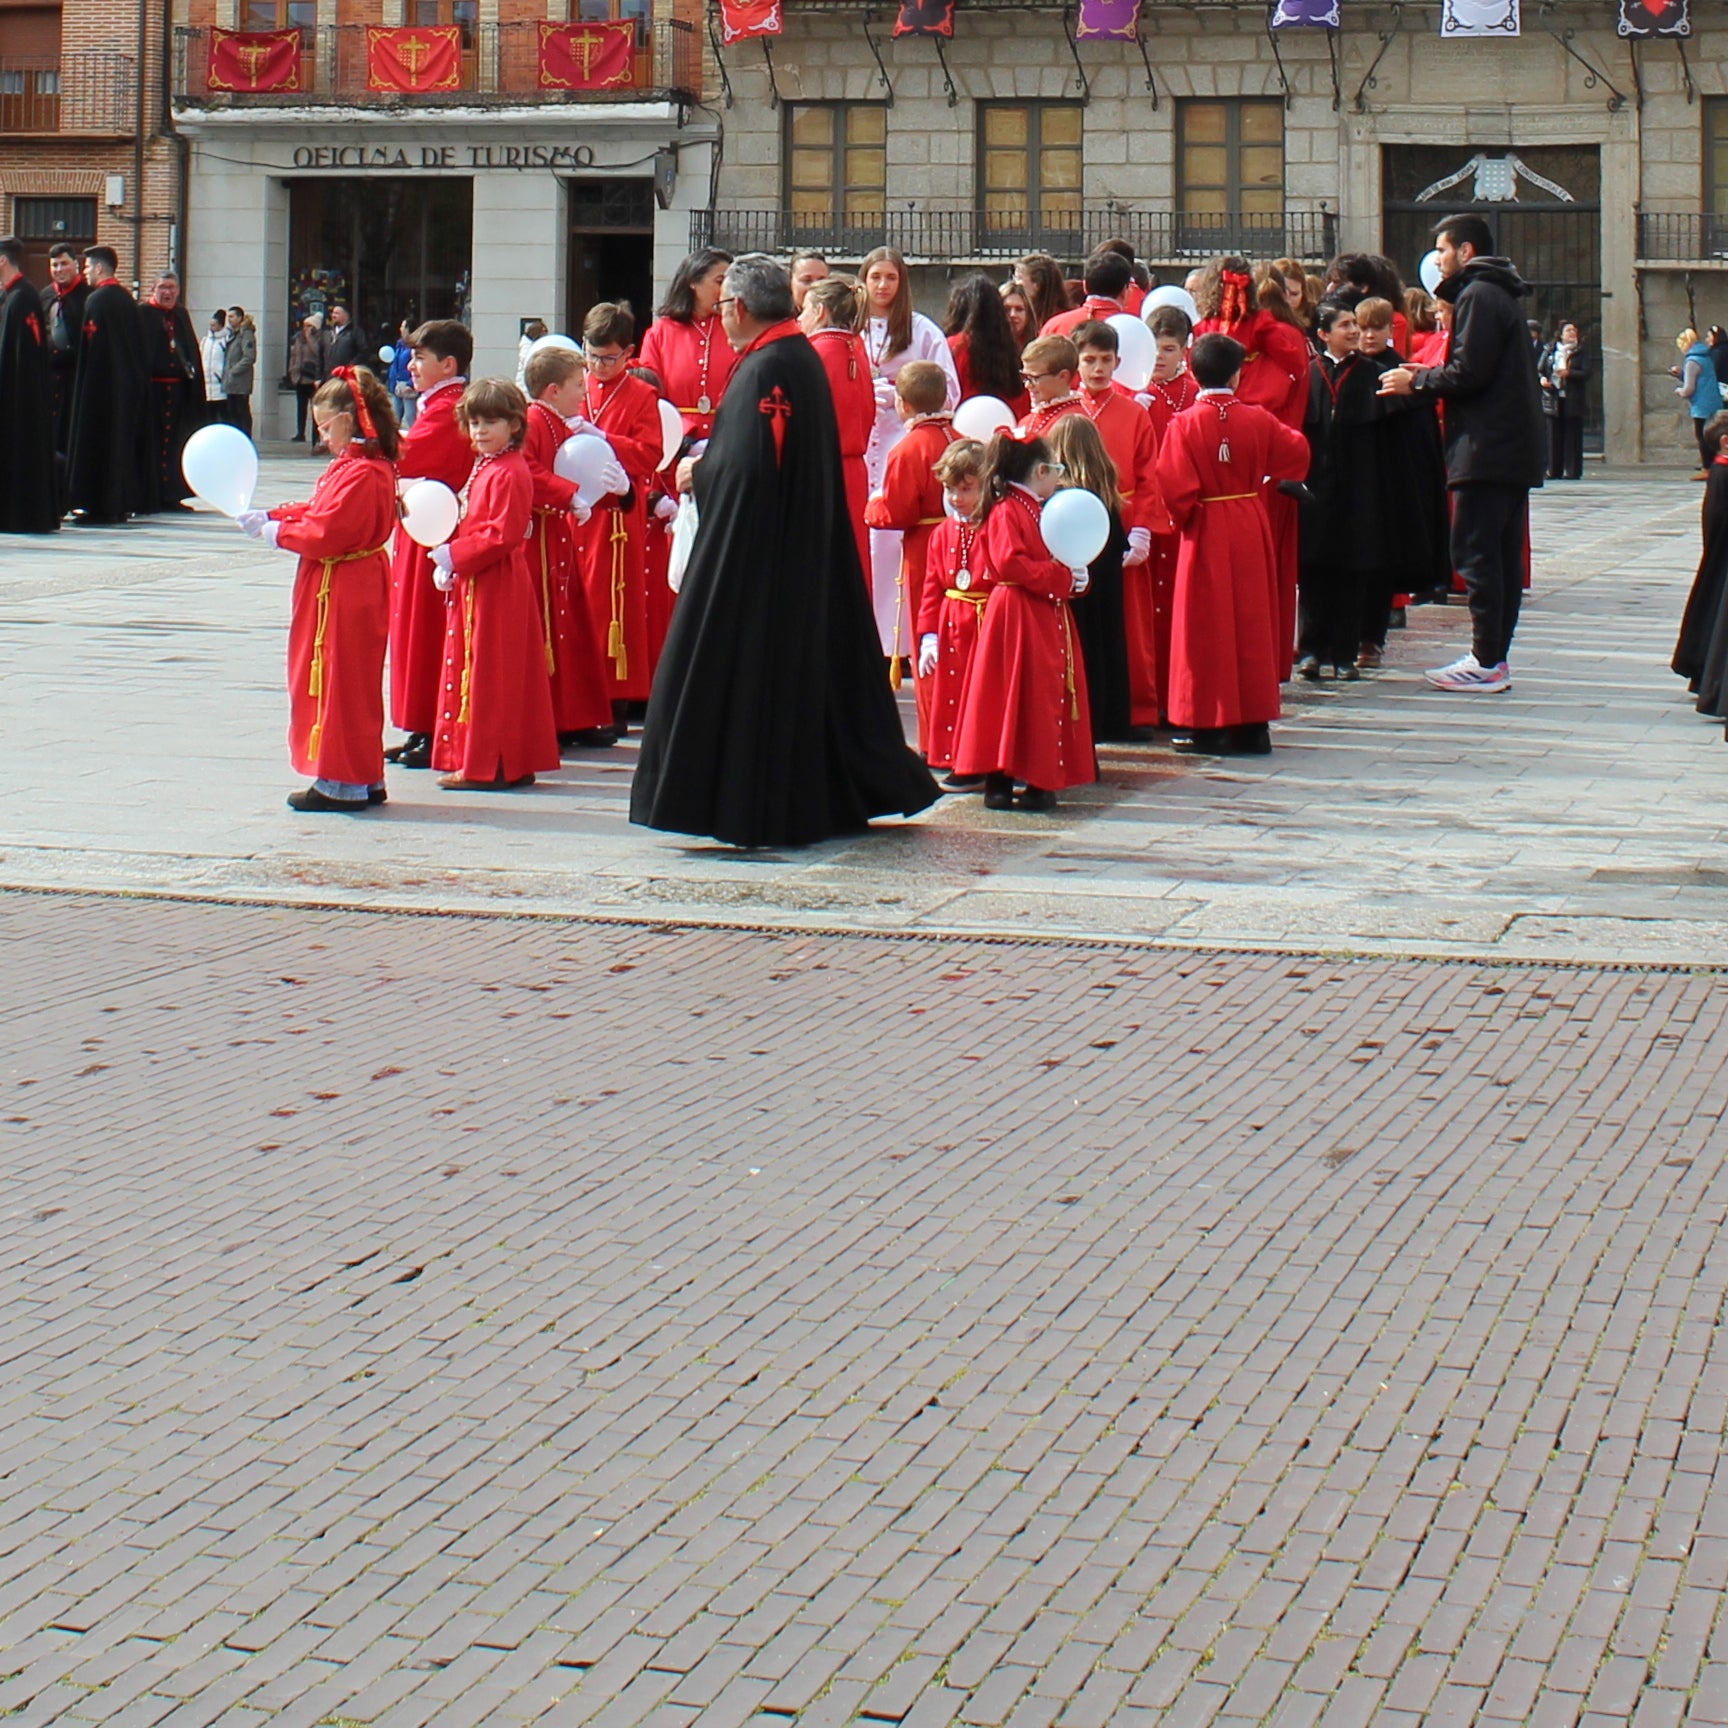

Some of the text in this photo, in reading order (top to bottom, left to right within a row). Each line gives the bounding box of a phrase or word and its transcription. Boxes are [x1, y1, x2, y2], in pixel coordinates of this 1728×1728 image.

[293, 146, 595, 170] OFICINA DE TURISMO
